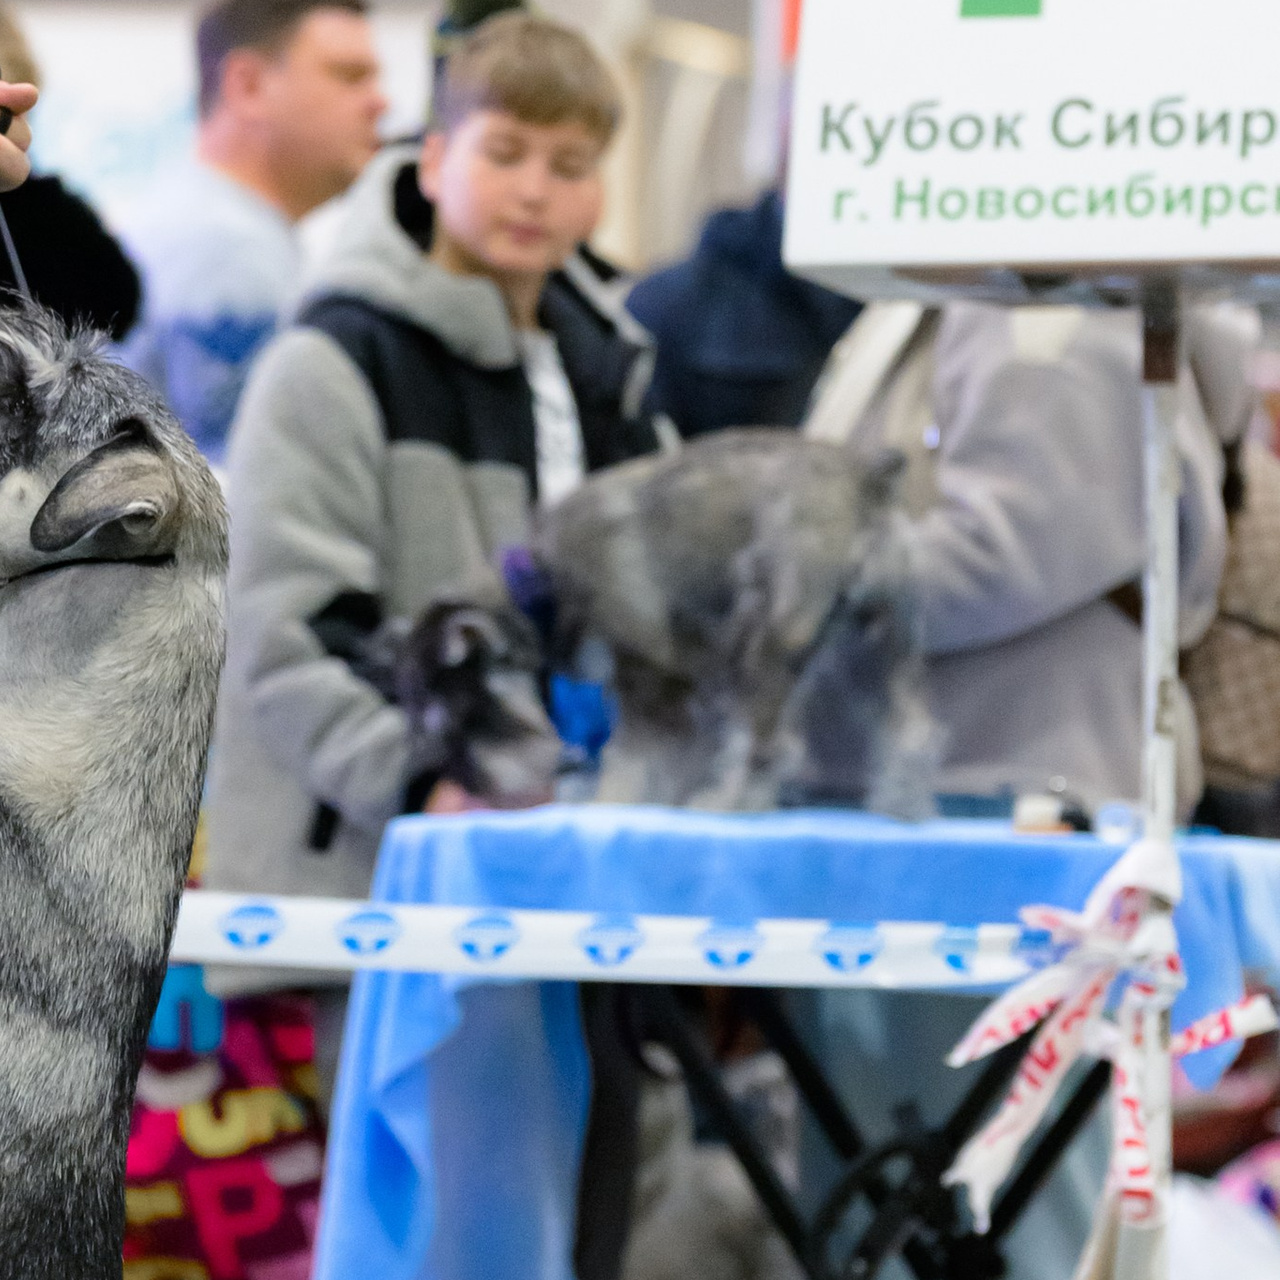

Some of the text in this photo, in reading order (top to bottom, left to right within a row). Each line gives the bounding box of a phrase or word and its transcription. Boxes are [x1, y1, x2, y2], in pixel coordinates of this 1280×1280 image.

[819, 100, 1023, 167] Кубок
[832, 170, 1280, 228] г. Новосибирс
